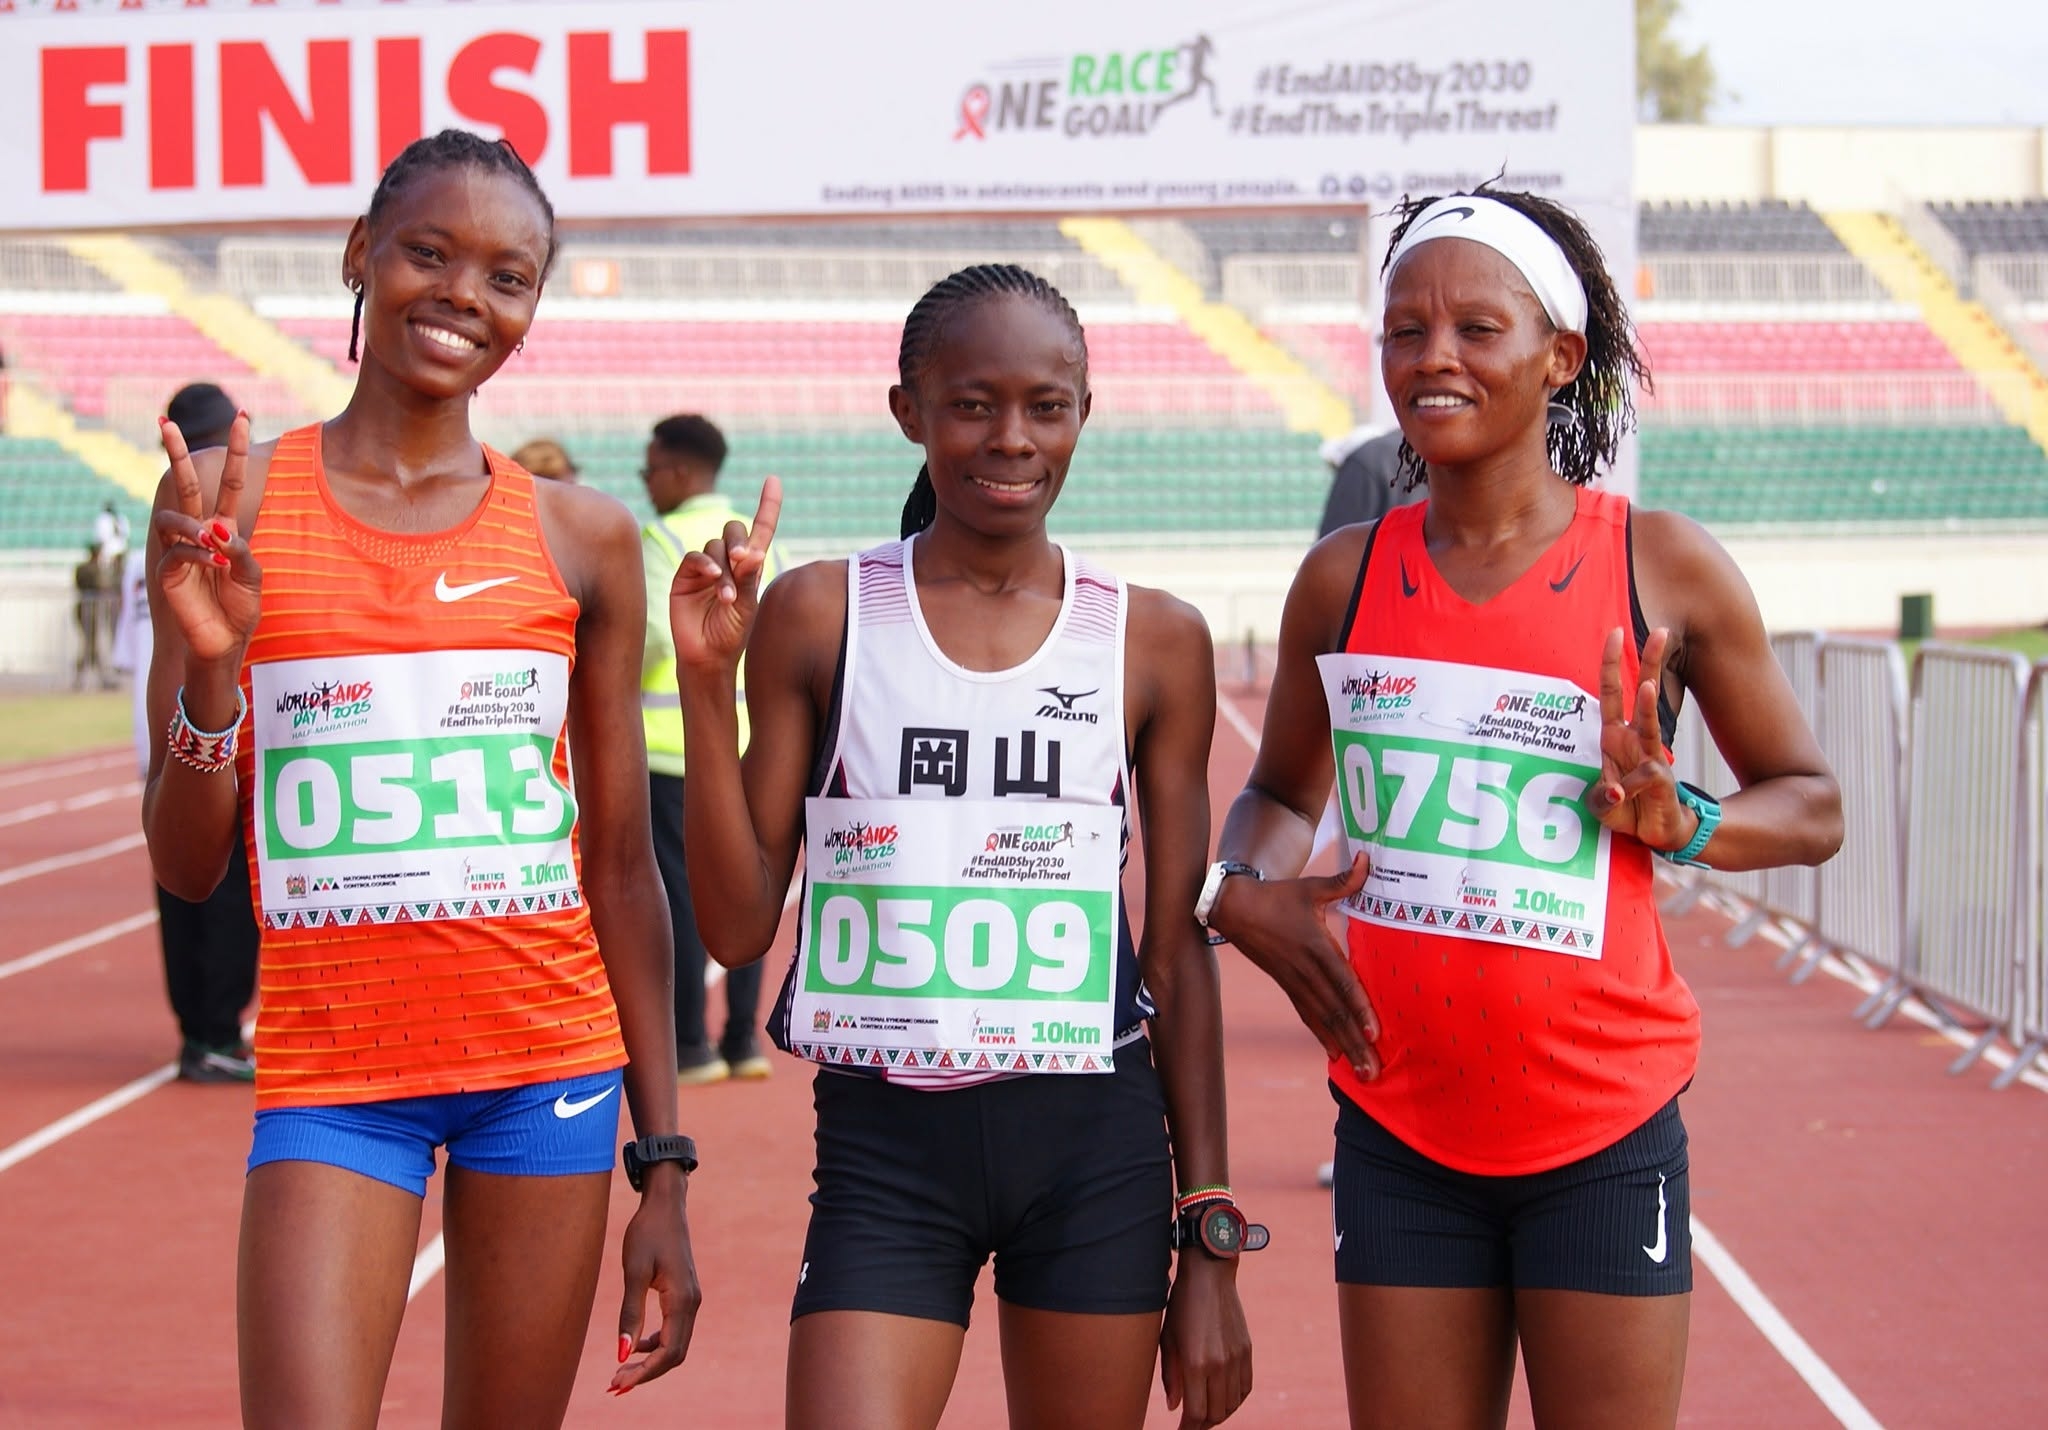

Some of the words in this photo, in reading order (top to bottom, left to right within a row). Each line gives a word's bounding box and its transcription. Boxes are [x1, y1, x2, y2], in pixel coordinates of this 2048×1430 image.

[1067, 50, 1178, 97] RACE
[40, 29, 692, 192] FINISH
[1063, 101, 1151, 138] GOAL
[1230, 102, 1559, 144] #EndTheTripleThreat
[460, 681, 493, 700] ONE
[494, 687, 524, 698] GOAL
[495, 672, 529, 687] RACE
[1341, 674, 1370, 698] WORLD
[1382, 675, 1417, 695] AIDS
[276, 691, 321, 714] WORLD
[336, 681, 374, 702] AIDS
[1351, 696, 1367, 713] DAY
[1376, 694, 1412, 710] 2025
[1494, 694, 1533, 713] ONE
[1530, 706, 1561, 721] GOAL
[1533, 691, 1573, 711] RACE
[294, 709, 318, 729] DAY
[332, 700, 372, 719] 2025
[440, 713, 541, 728] #EndTheTripleThreat
[291, 717, 368, 740] HALF-MARATHON
[898, 727, 1060, 798] 岡山
[275, 744, 565, 850] 0513
[1343, 743, 1588, 864] 0756
[824, 827, 856, 853] WORLD
[865, 825, 898, 845] AIDS
[984, 833, 1021, 852] ONE
[1021, 841, 1054, 852] GOAL
[1024, 825, 1061, 840] RACE
[835, 848, 854, 865] DAY
[863, 843, 896, 860] 2025
[520, 862, 569, 886] 10km
[962, 867, 1071, 882] #EndTheTripleThreat
[471, 881, 507, 891] KENYA
[1463, 886, 1498, 898] ATHLETICS
[1462, 895, 1497, 908] KENYA
[1512, 888, 1585, 921] 10km
[818, 895, 1091, 993] 0509
[979, 1035, 1016, 1044] KENYA
[1032, 1021, 1101, 1044] 10km
